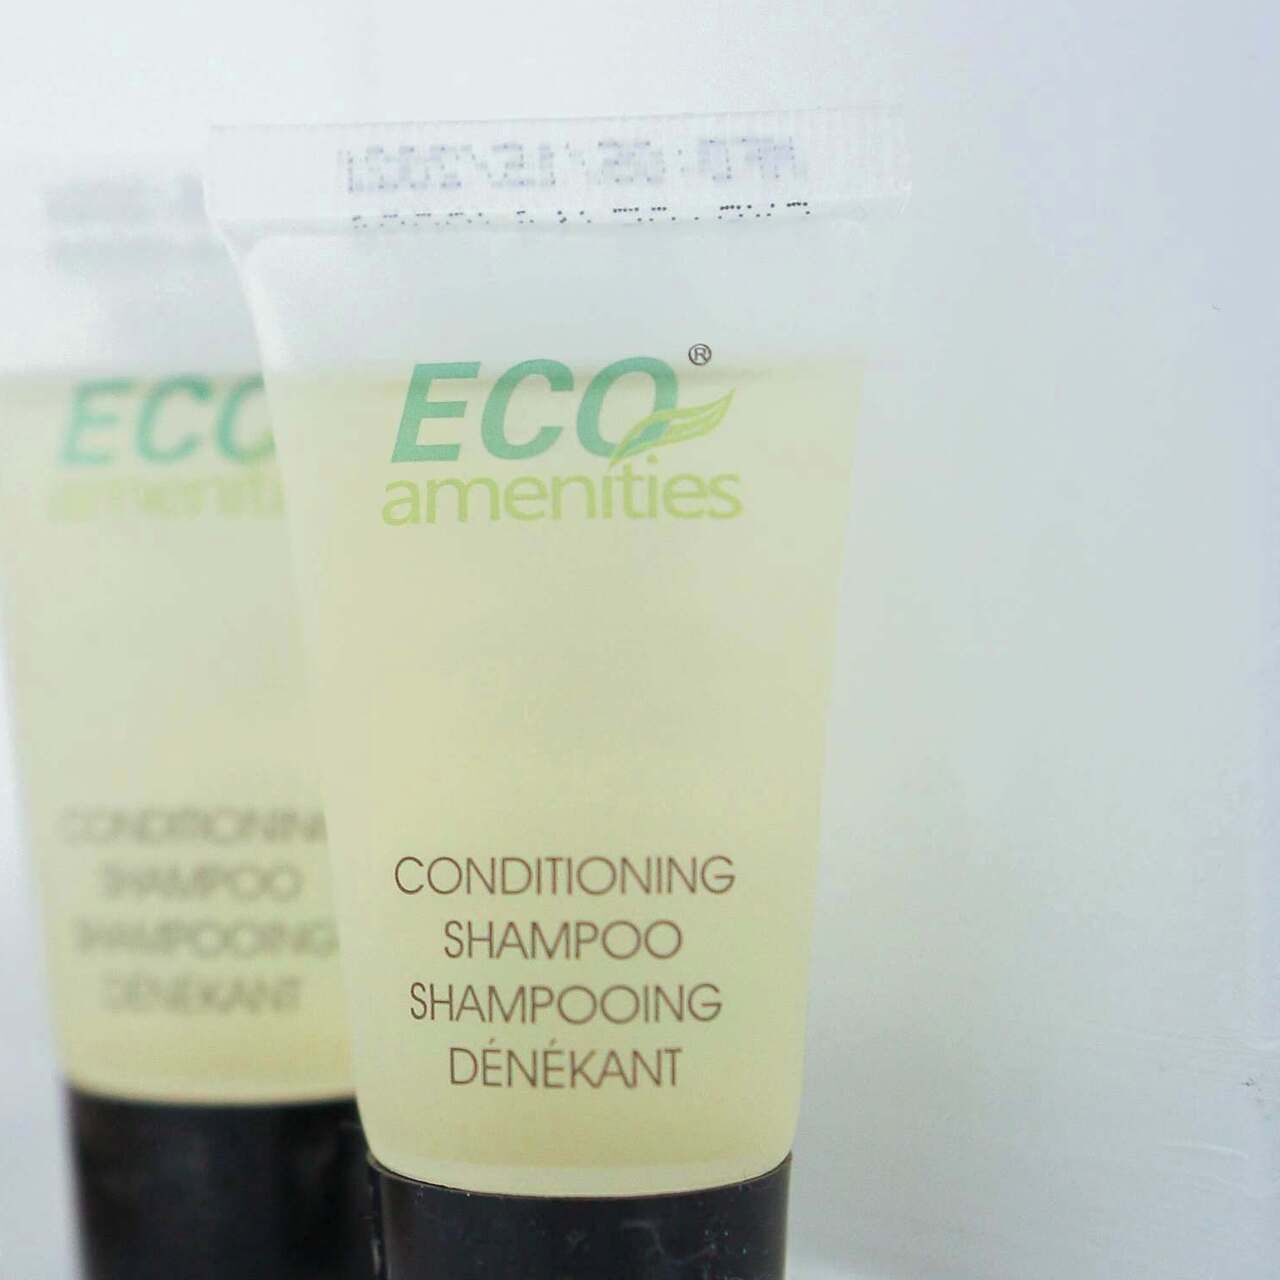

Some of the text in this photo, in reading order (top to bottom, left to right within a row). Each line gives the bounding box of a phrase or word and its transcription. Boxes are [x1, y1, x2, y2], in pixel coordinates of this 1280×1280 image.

[389, 355, 680, 464] ECO
[380, 451, 745, 527] amenities
[393, 854, 737, 896] CONDITIONING
[442, 918, 685, 960] SHAMPOO
[408, 980, 724, 1026] SHAMPOOING
[448, 1037, 685, 1090] DÉNÉKANT
